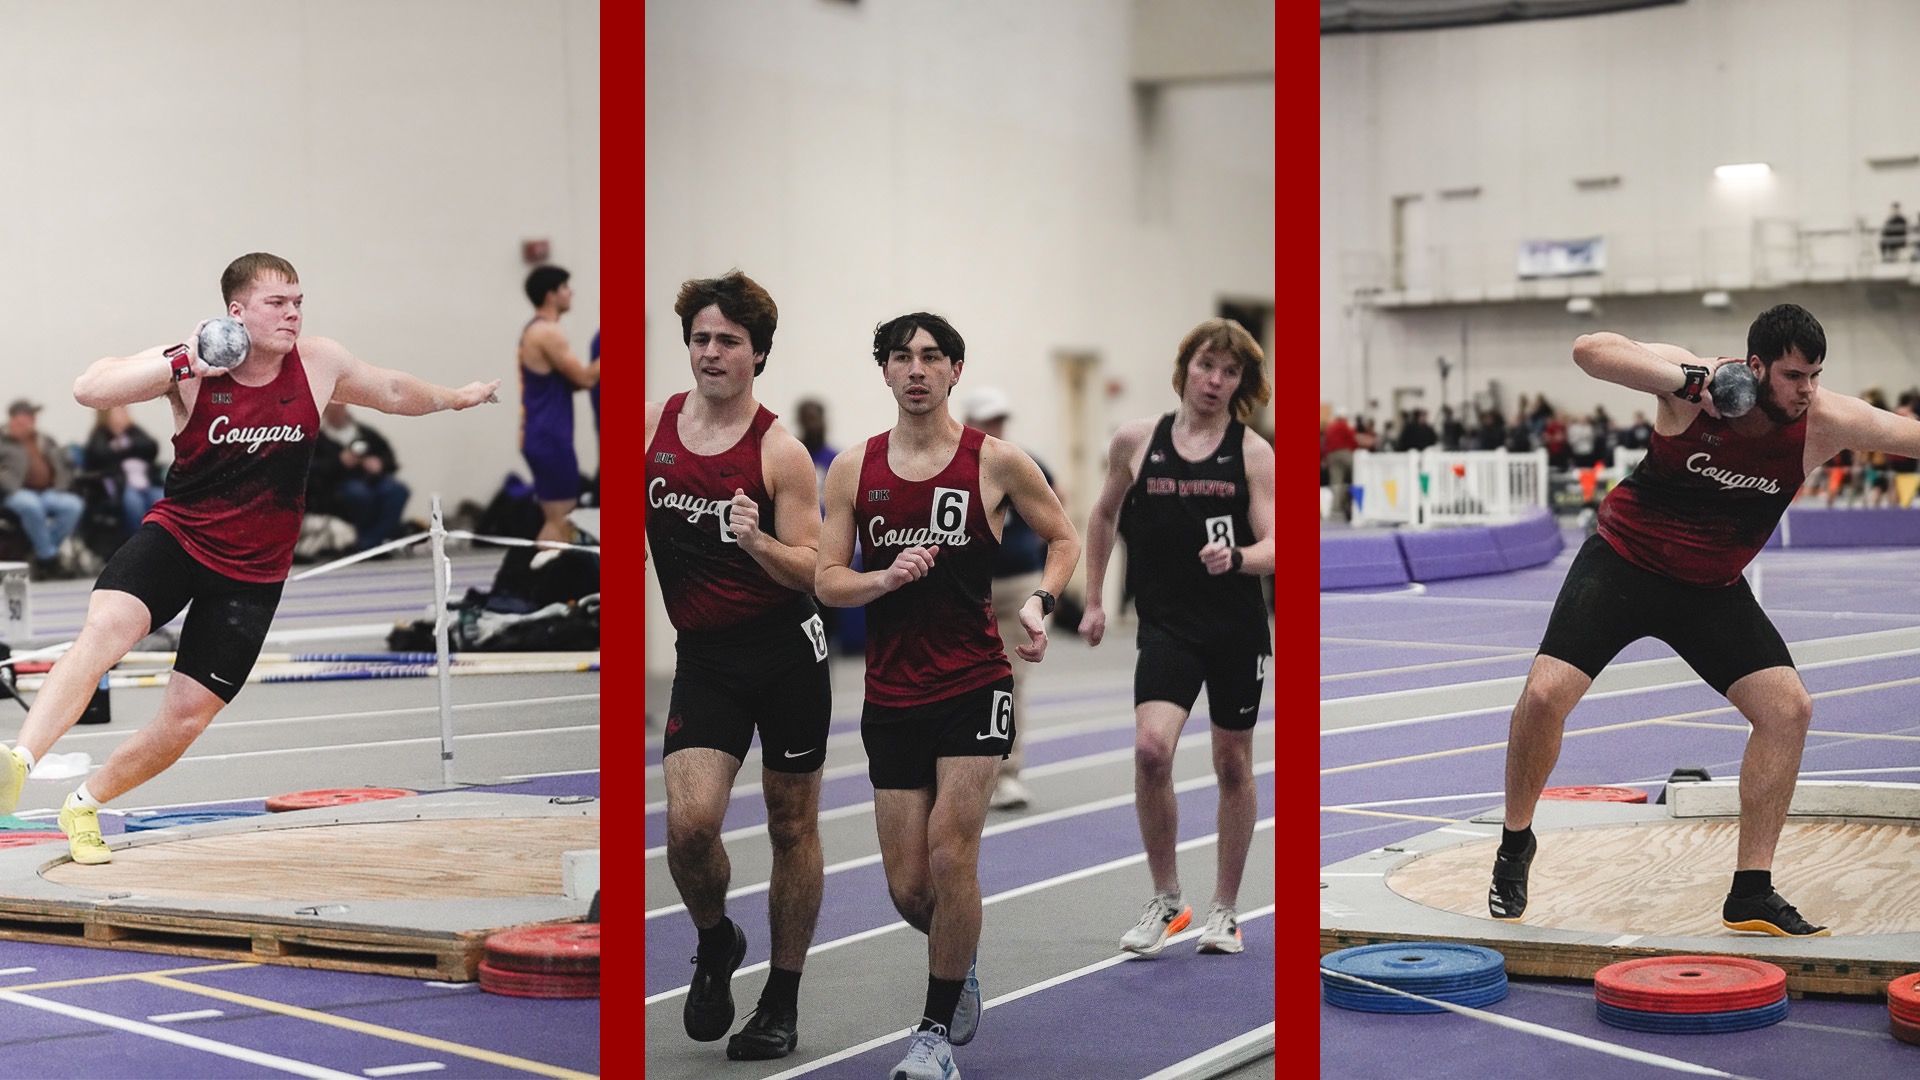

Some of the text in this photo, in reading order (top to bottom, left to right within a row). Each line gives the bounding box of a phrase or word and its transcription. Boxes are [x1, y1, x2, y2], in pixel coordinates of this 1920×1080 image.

[208, 415, 305, 454] Cougars
[1146, 477, 1236, 497] RED WOLVES
[1686, 452, 1780, 494] Cougars
[648, 476, 720, 524] Couga
[868, 489, 889, 502] IUK
[936, 491, 963, 532] 6
[810, 619, 825, 656] 6
[996, 695, 1010, 735] 6
